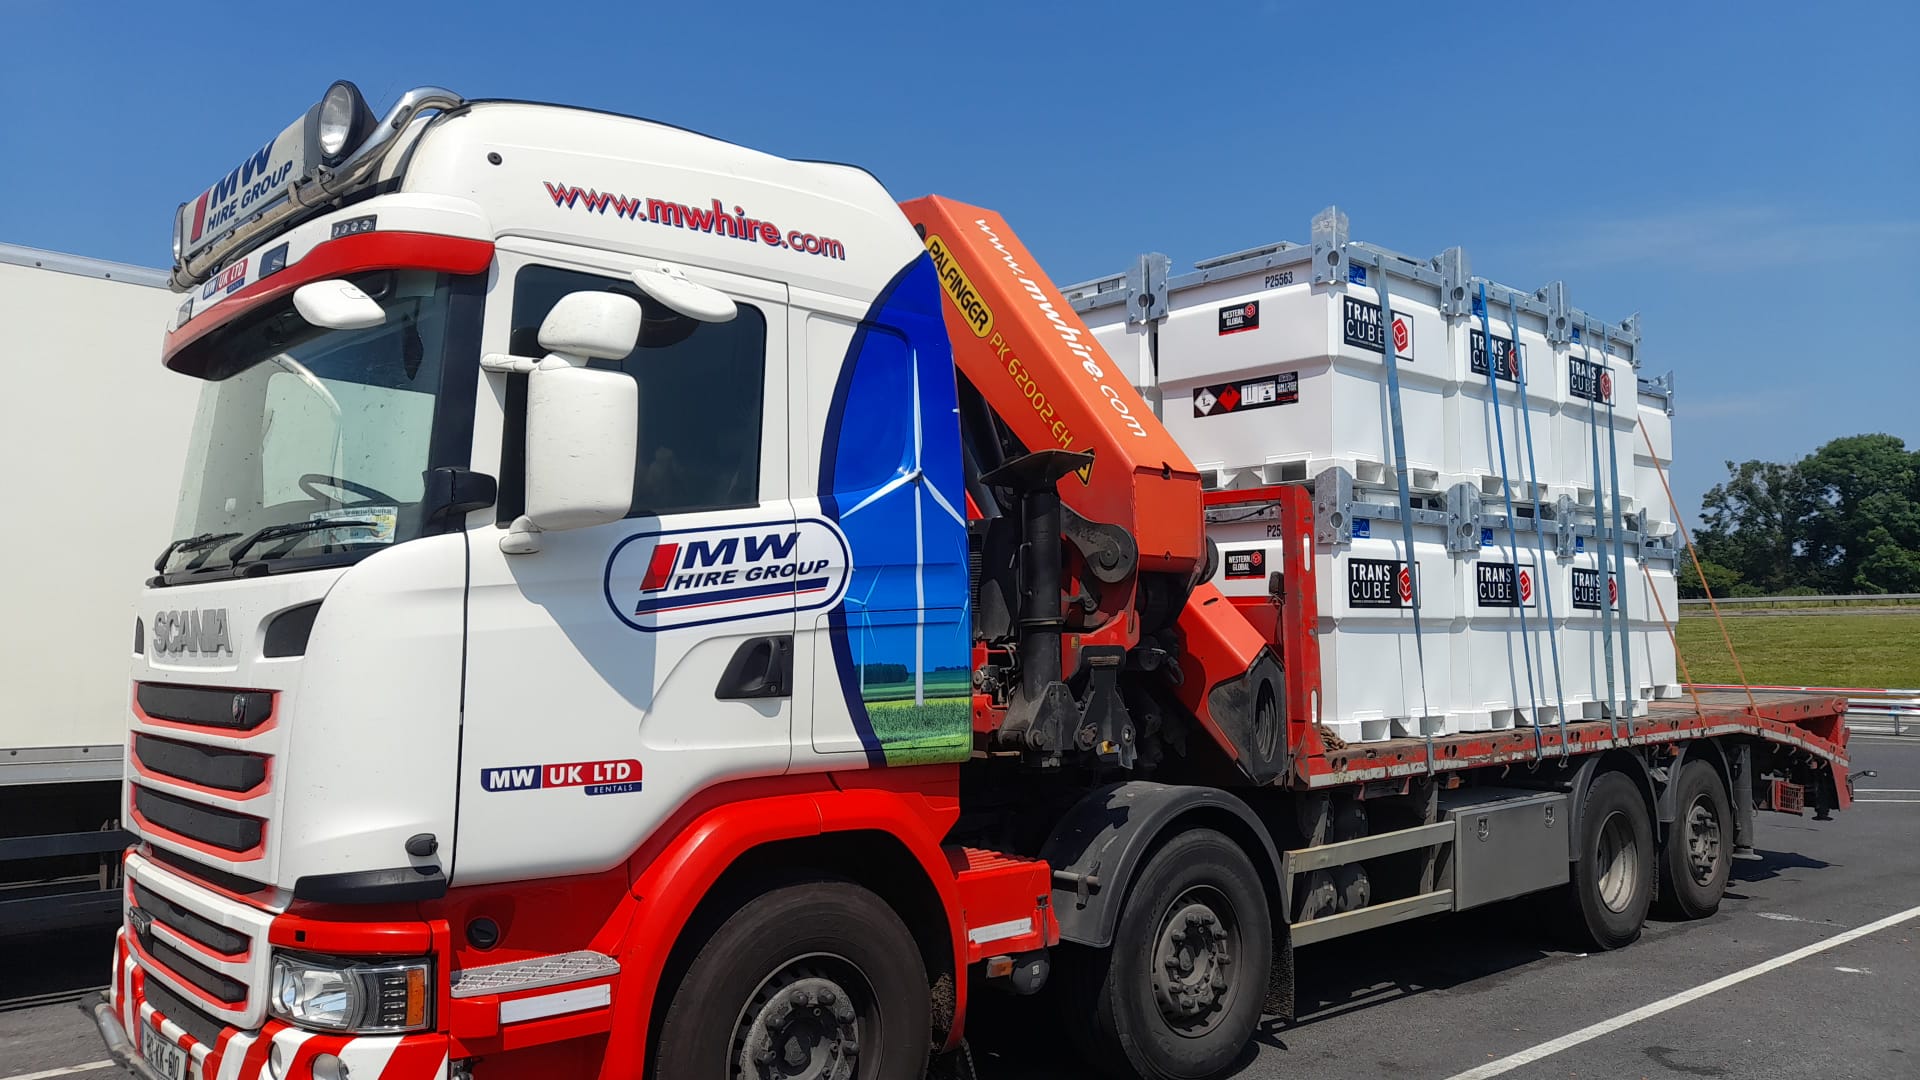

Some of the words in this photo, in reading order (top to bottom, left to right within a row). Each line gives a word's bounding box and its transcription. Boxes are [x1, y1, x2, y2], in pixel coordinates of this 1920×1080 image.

[211, 138, 276, 210] MW
[207, 198, 238, 233] HIRE
[241, 160, 293, 209] GROUP
[543, 181, 845, 260] www.mwhire.com
[204, 278, 218, 299] MW
[218, 270, 231, 289] UK
[231, 262, 244, 281] LTD
[929, 240, 988, 331] PALFINGER
[1265, 271, 1293, 288] P25563
[1222, 308, 1245, 319] WESTERN
[1226, 316, 1244, 326] GLOBAL
[1346, 302, 1383, 326] TRANS
[975, 219, 1147, 438] www.mwhire.com
[1346, 319, 1384, 344] CUBE
[1472, 333, 1504, 356] TRNS
[1570, 360, 1597, 380] TRANS
[989, 332, 1011, 361] PK
[1008, 359, 1074, 449] 62002-EH
[1571, 374, 1597, 394] CUBE
[1266, 524, 1282, 537] P25
[681, 531, 801, 569] MW
[1228, 555, 1251, 564] WESTERN
[673, 569, 740, 591] HIRE
[744, 559, 830, 582] GROUP
[1351, 563, 1391, 581] TRANS
[1479, 567, 1511, 583] TRANS
[1574, 572, 1601, 588] TRANS
[1351, 581, 1391, 599] CUBE
[1479, 583, 1513, 599] CUBE
[1574, 586, 1601, 602] CUBE
[154, 608, 233, 654] SCANIA
[489, 768, 535, 789] MW
[549, 765, 583, 785] UK
[593, 762, 632, 782] LTD
[594, 784, 633, 794] RENTALS
